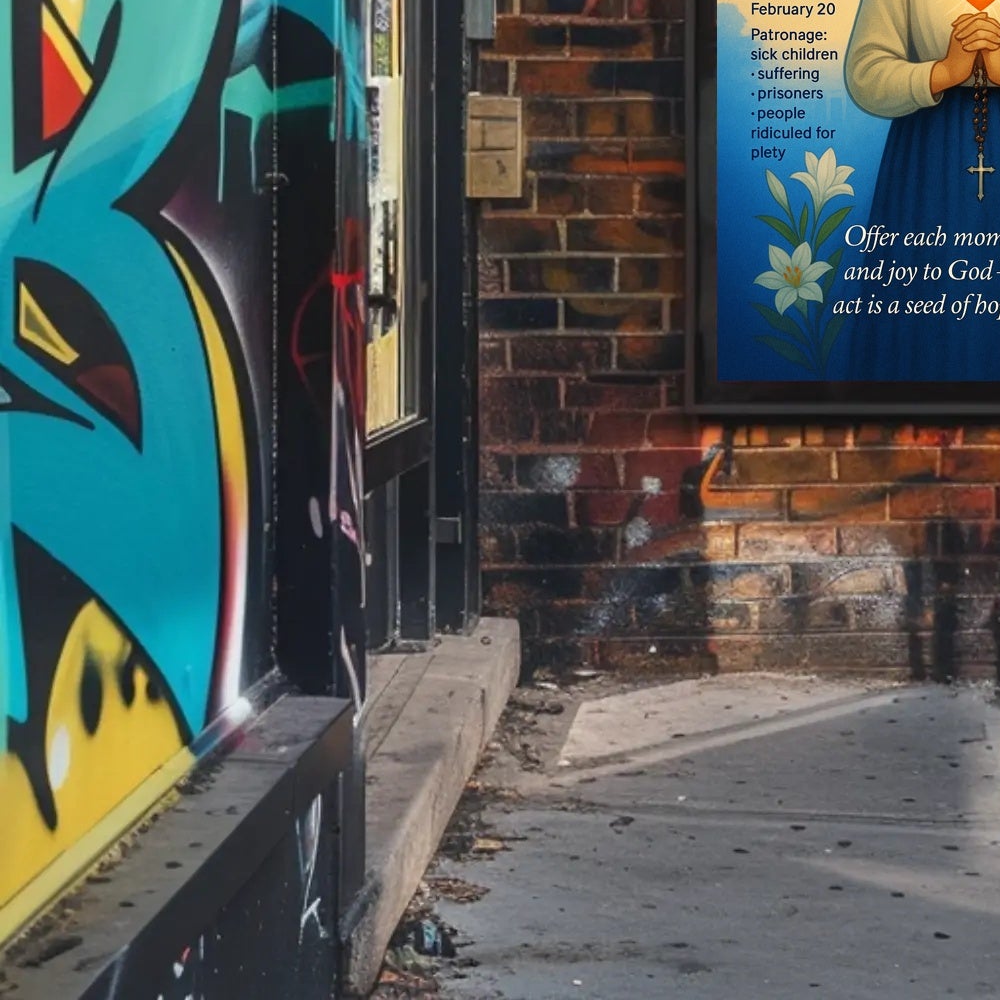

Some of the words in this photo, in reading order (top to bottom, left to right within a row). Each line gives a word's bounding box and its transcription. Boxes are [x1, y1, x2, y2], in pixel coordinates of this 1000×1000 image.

[751, 3, 813, 18] February
[817, 3, 836, 15] 20
[751, 28, 827, 43] Patronage:
[751, 48, 777, 60] sick
[782, 48, 838, 60] children
[758, 67, 820, 82] suffering
[758, 87, 823, 101] prisoners
[757, 107, 806, 121] people
[751, 126, 812, 139] ridiculed
[816, 126, 836, 139] for
[751, 146, 786, 161] plety
[844, 224, 899, 252] Offer
[903, 226, 947, 247] each
[844, 260, 883, 281] and
[886, 261, 918, 287] joy
[923, 262, 942, 281] to
[833, 297, 863, 315] act
[868, 294, 882, 315] is
[887, 300, 900, 315] a
[905, 294, 947, 315] seed
[951, 294, 974, 320] of
